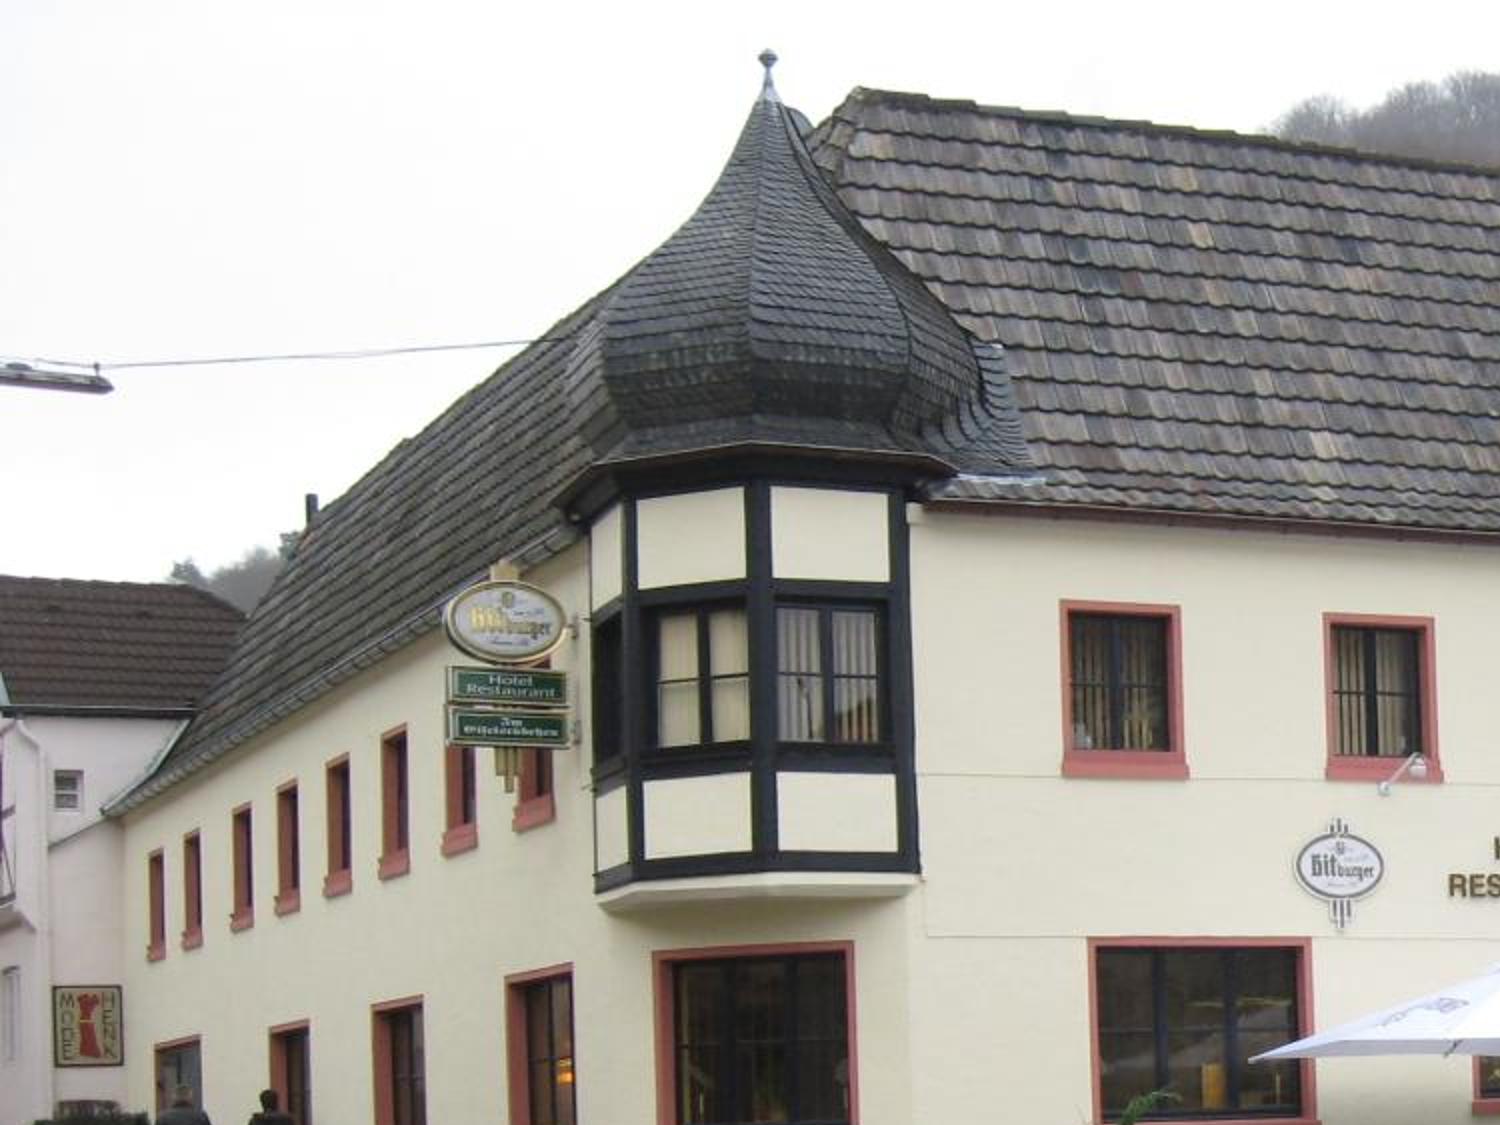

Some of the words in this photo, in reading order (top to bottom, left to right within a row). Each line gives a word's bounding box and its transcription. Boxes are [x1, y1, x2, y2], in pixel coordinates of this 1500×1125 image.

[488, 674, 533, 686] Hotel
[466, 684, 556, 698] Restaurant
[1311, 853, 1374, 882] Bitburger
